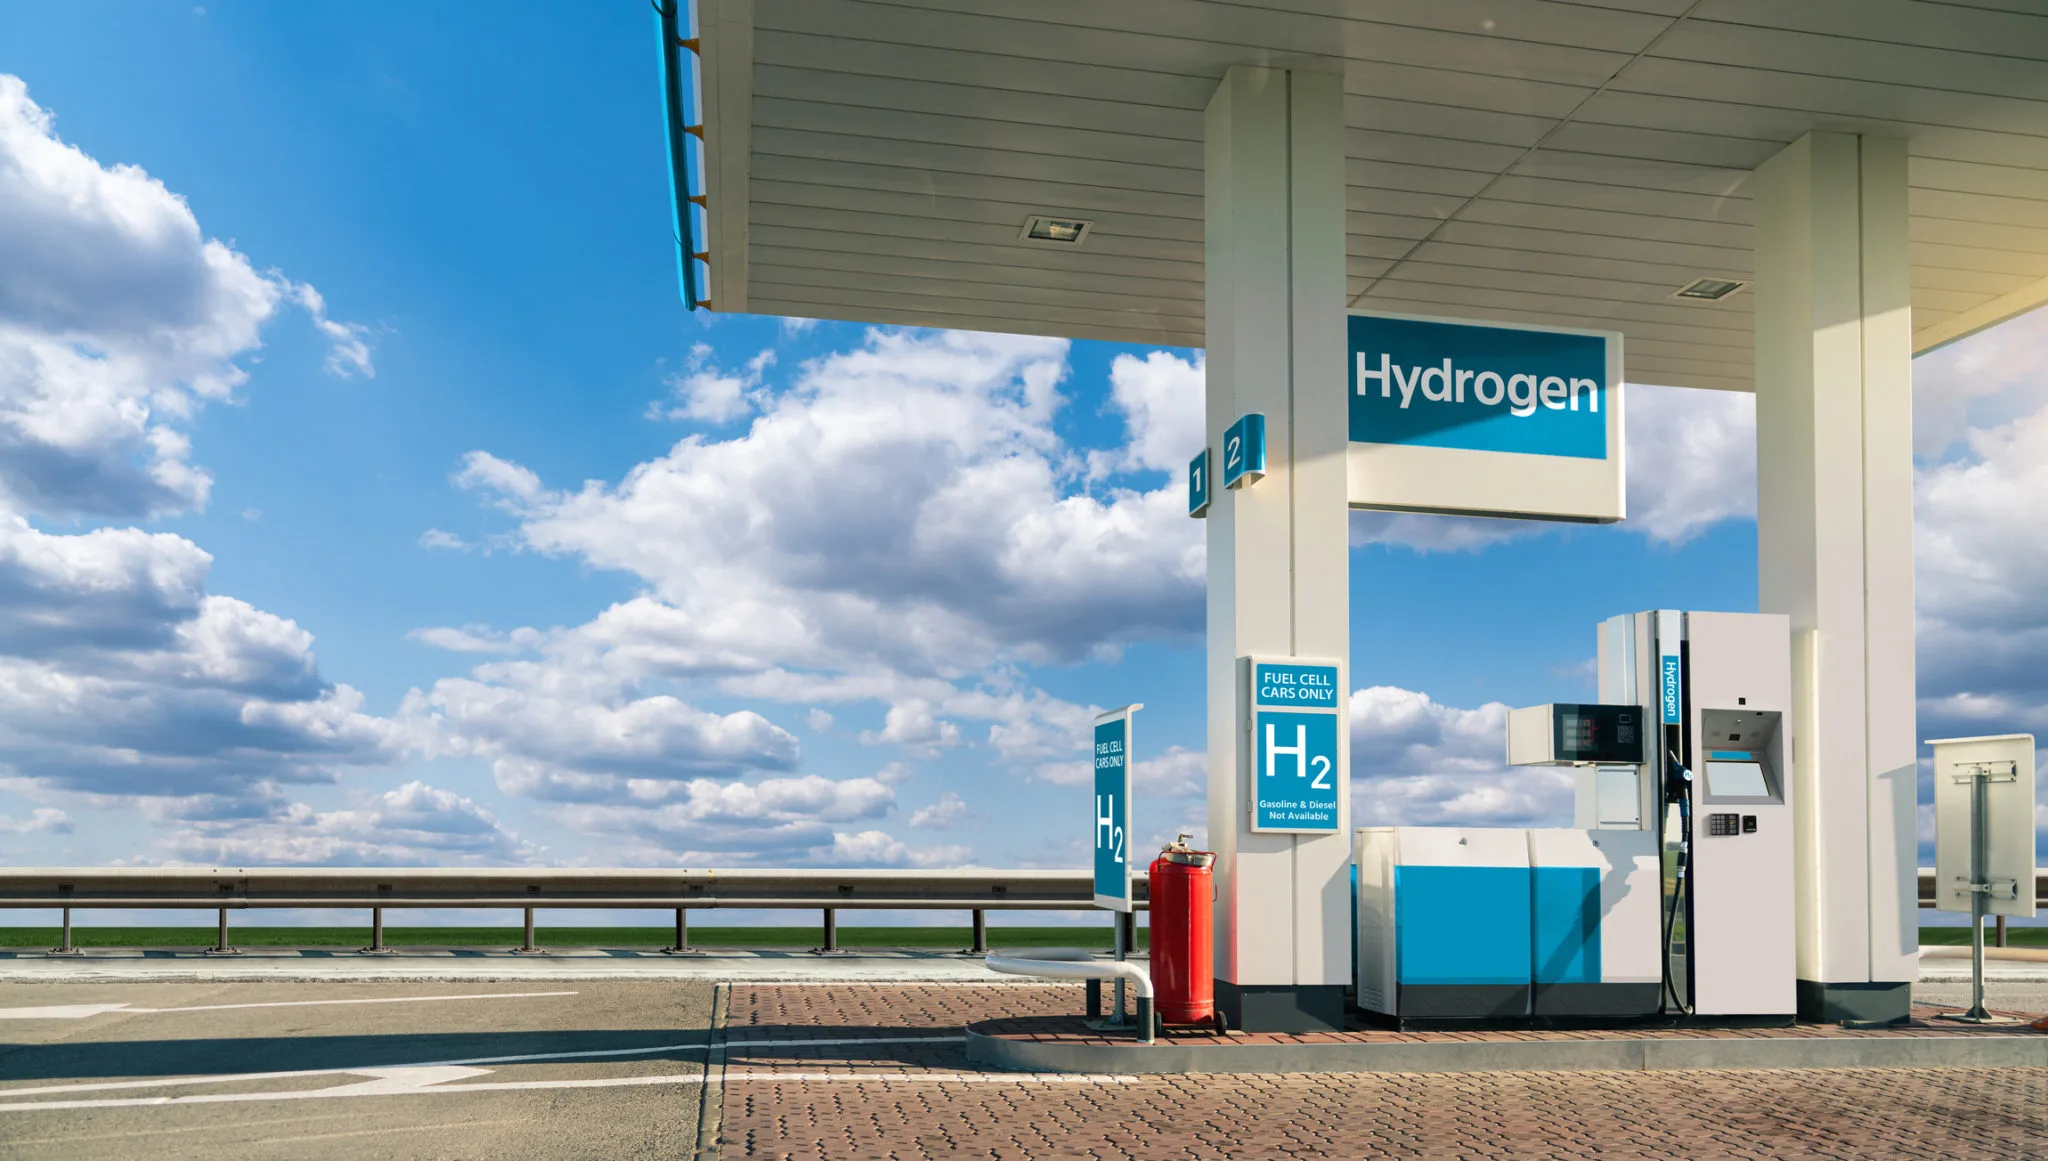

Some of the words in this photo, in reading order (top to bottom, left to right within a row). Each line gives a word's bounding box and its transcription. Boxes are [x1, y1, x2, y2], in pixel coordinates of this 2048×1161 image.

[1356, 351, 1599, 418] Hydrogen
[1227, 436, 1241, 471] 2
[1192, 466, 1201, 493] 1
[1264, 672, 1297, 685] FUEL
[1299, 673, 1331, 686] CELL
[1261, 686, 1296, 699] CARS
[1298, 687, 1334, 700] ONLY
[1664, 661, 1677, 717] Hydrogen
[1097, 744, 1109, 754] FUEL
[1110, 740, 1122, 752] CELL
[1096, 757, 1109, 768] CARS
[1110, 755, 1123, 767] ONLY
[1259, 799, 1298, 809] Gasoline
[1299, 800, 1307, 809] &
[1309, 800, 1337, 810] Diesel
[1269, 811, 1286, 820] Not
[1287, 811, 1329, 821] Available
